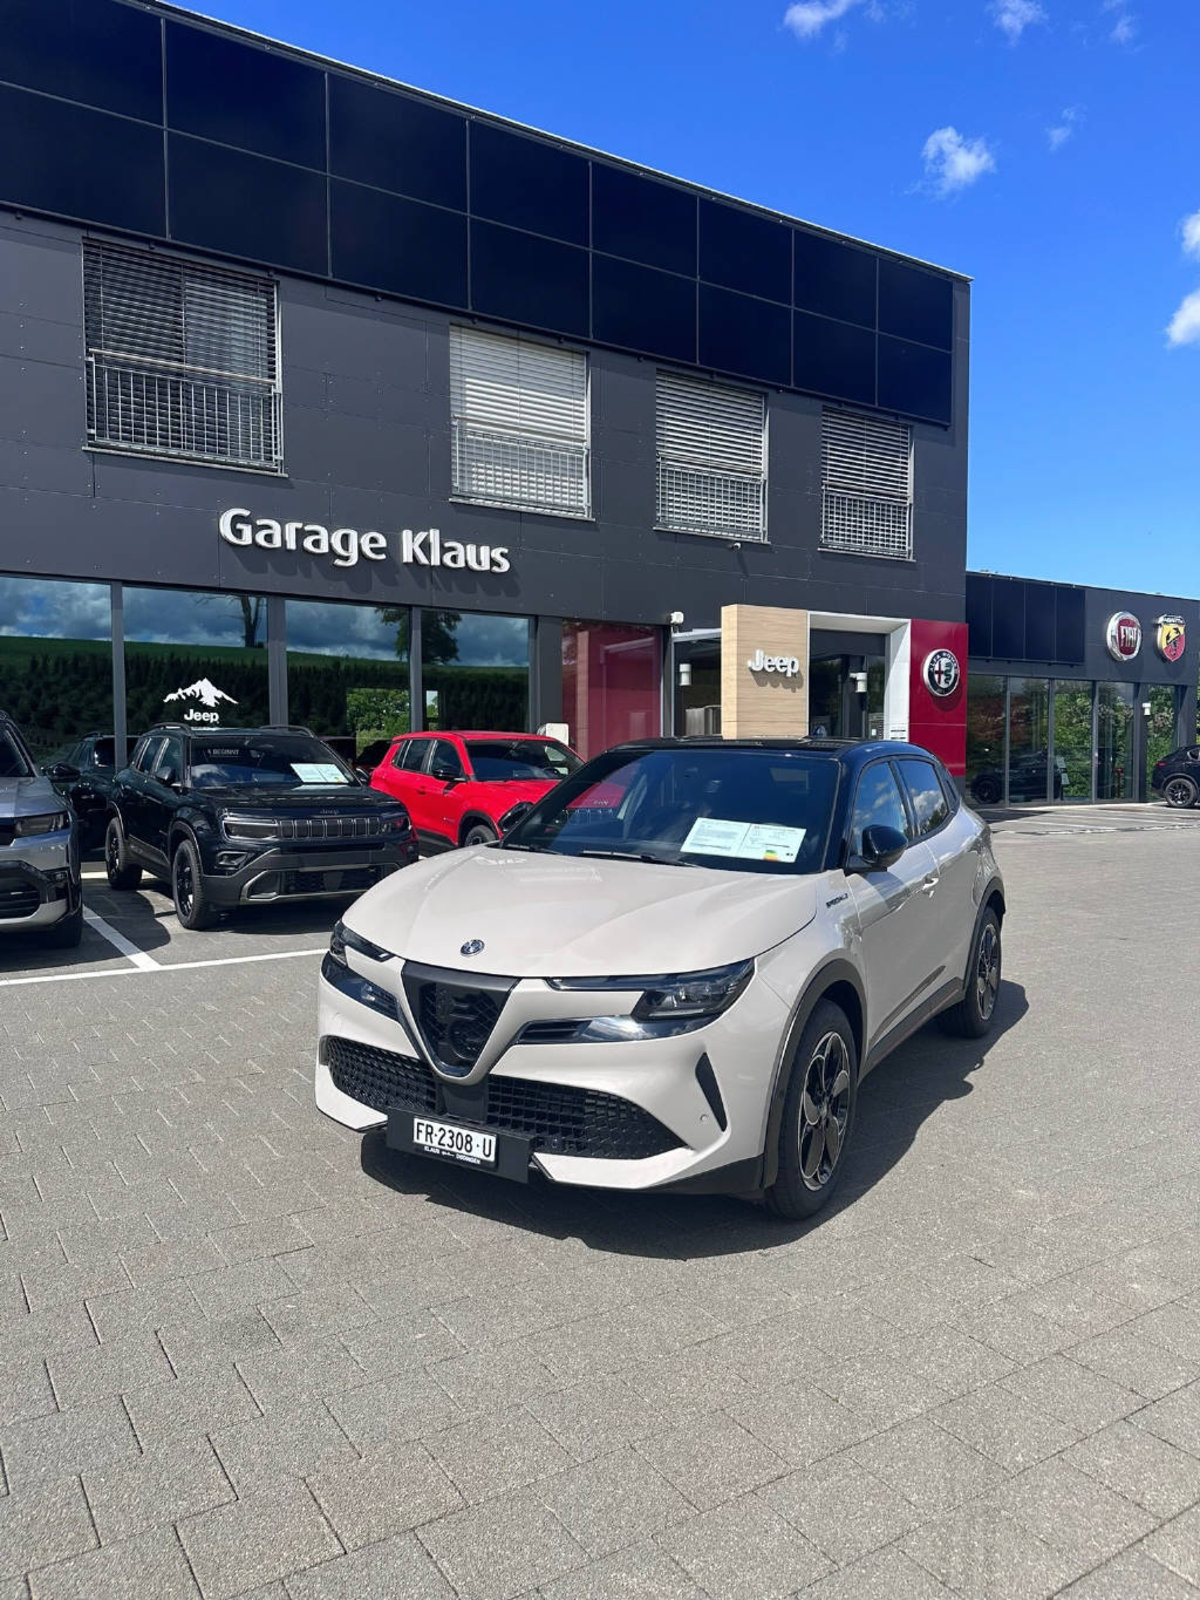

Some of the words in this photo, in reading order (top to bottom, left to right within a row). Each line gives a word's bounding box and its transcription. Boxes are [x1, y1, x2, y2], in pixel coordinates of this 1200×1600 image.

[218, 507, 388, 567] Garage
[402, 528, 511, 573] Klaus
[747, 649, 800, 677] Jeep
[183, 708, 219, 723] Jeep
